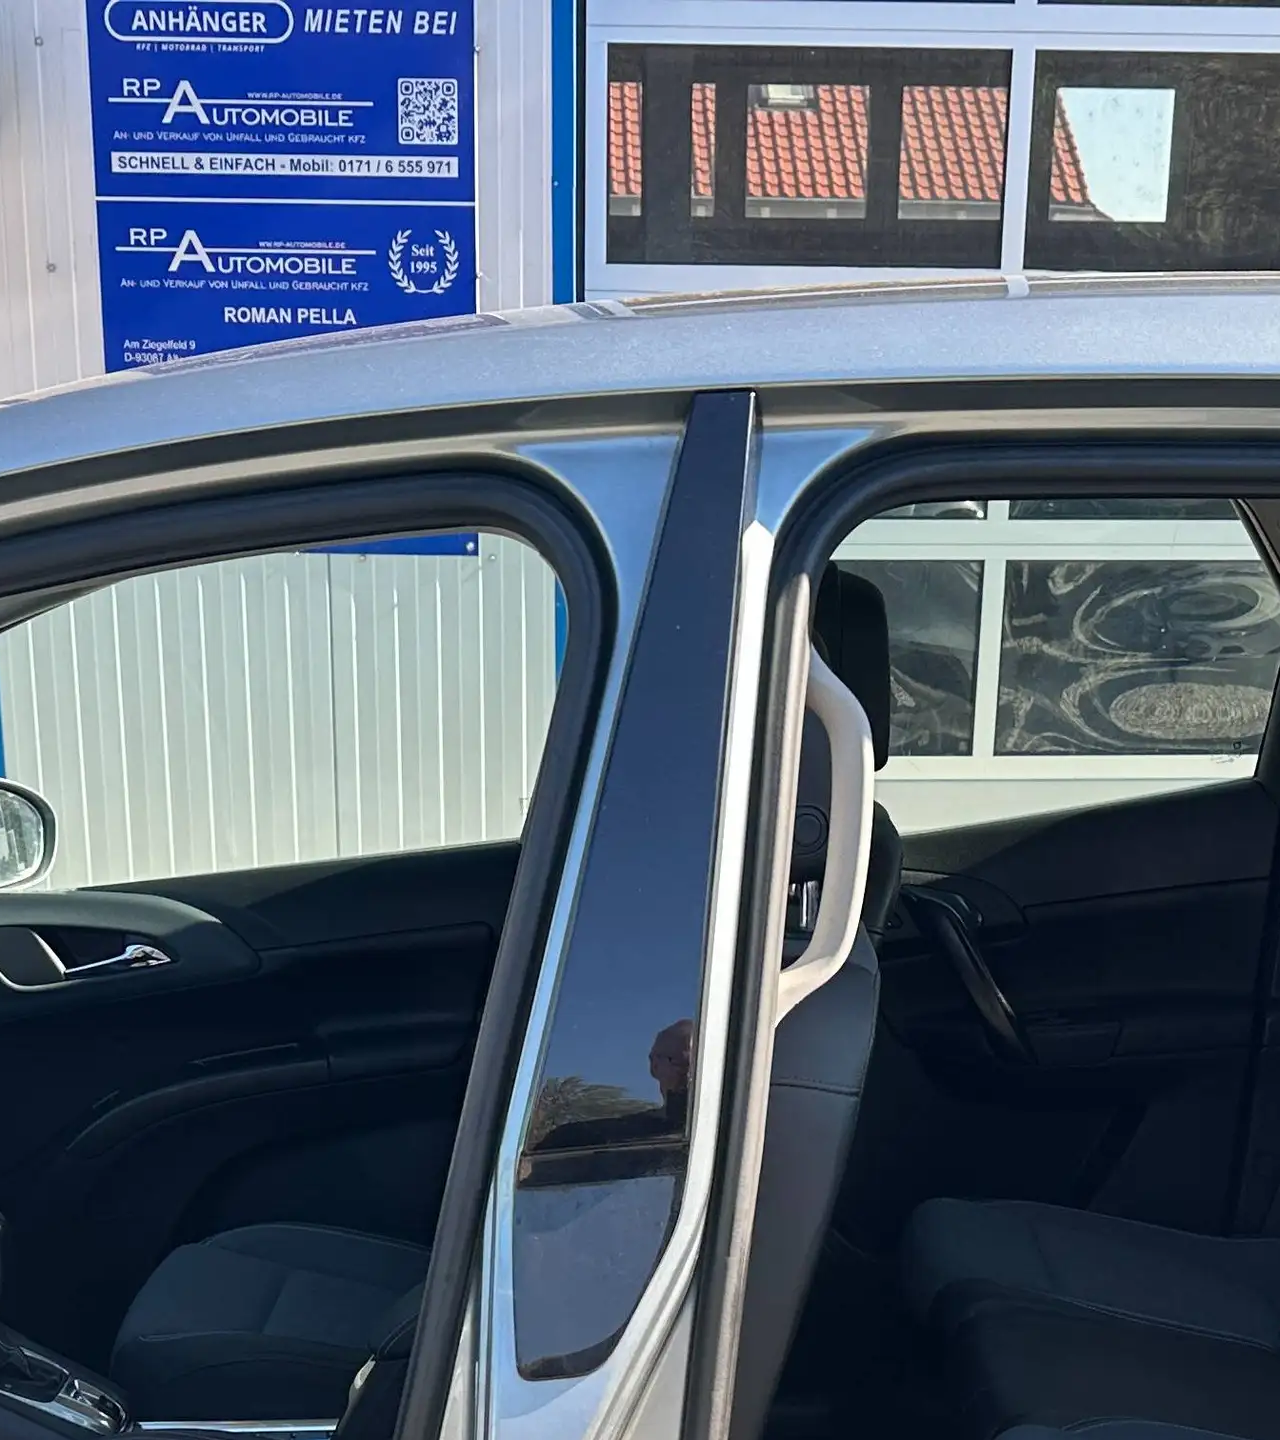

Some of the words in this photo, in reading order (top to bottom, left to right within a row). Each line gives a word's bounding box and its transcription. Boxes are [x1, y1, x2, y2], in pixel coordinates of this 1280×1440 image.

[131, 5, 267, 33] ANHÄNGER
[304, 9, 403, 34] MIETEN
[414, 10, 457, 35] BEI
[122, 78, 161, 97] RP
[118, 155, 190, 170] SCHNELL
[194, 157, 205, 170] &
[209, 157, 276, 171] EINFACH
[289, 159, 334, 172] Mobil:
[338, 159, 371, 173] 0171
[385, 160, 393, 173] 6
[398, 160, 423, 174] 555
[427, 161, 451, 174] 971
[129, 227, 167, 246] RP
[411, 244, 434, 257] Seit
[410, 261, 437, 274] 1995
[224, 306, 291, 323] ROMAN
[297, 308, 356, 325] PELLA
[123, 339, 139, 349] Am
[142, 339, 187, 351] Ziegelfeld
[189, 340, 195, 350] 9
